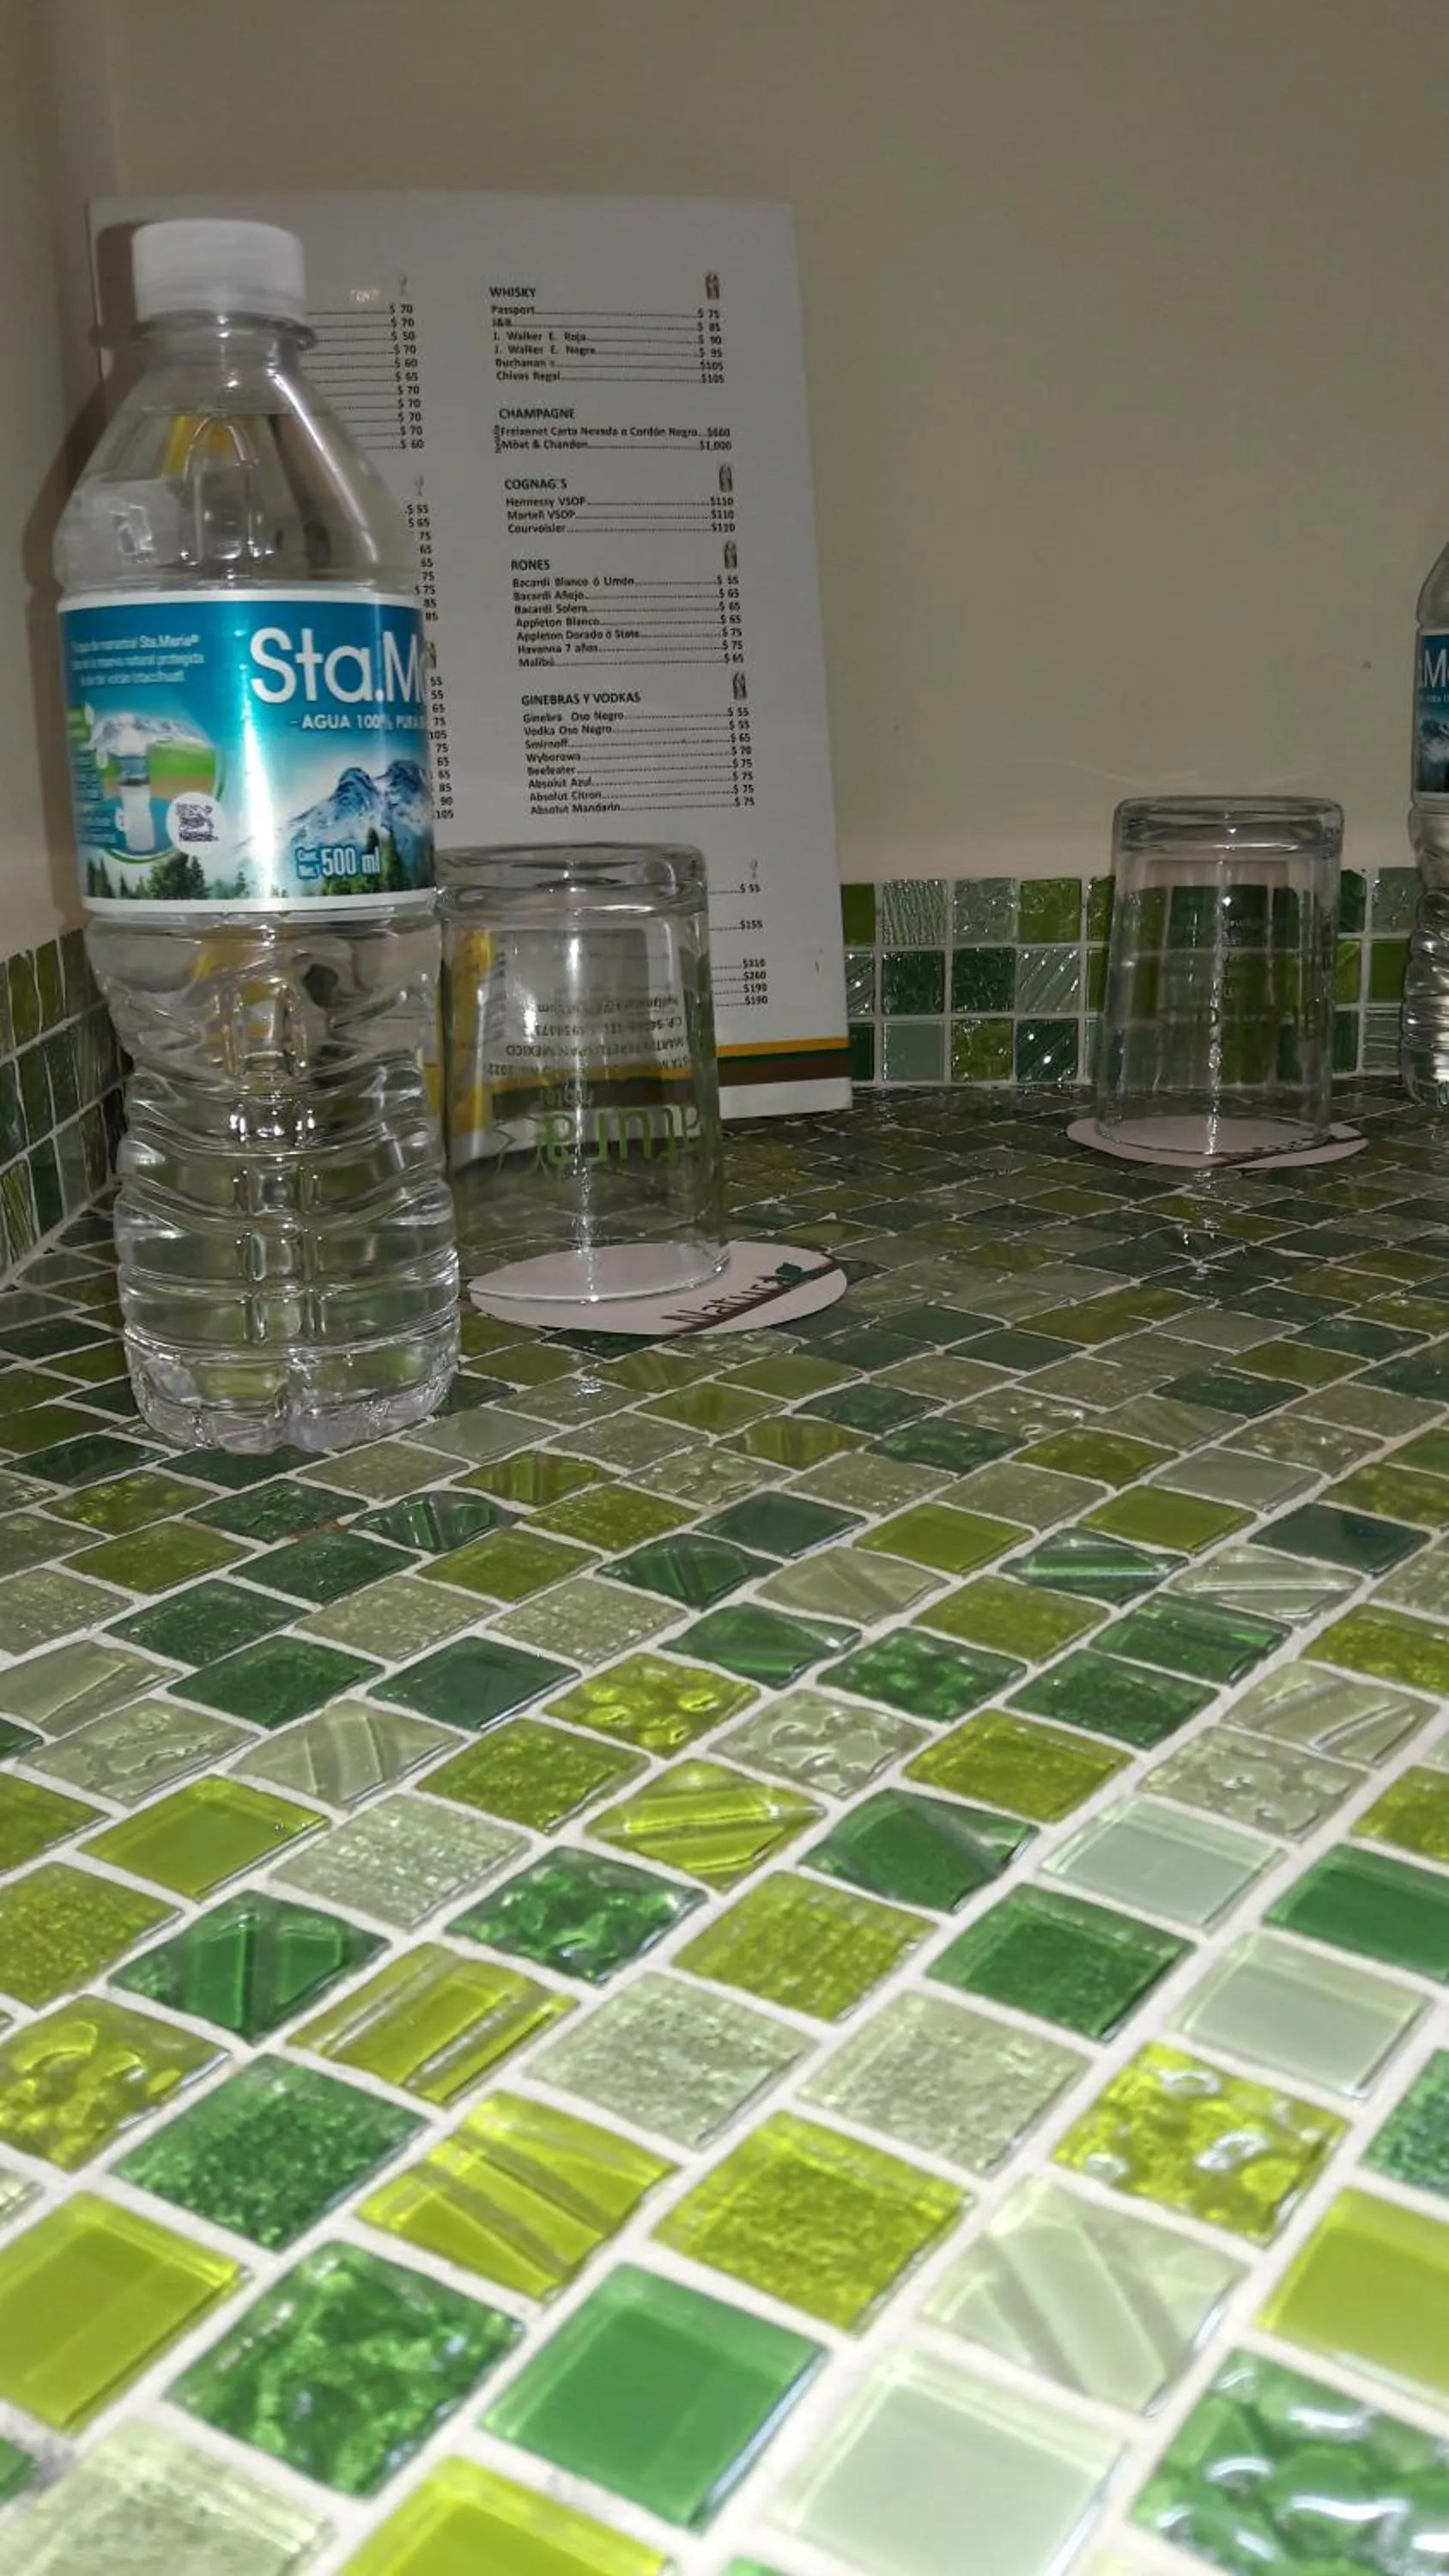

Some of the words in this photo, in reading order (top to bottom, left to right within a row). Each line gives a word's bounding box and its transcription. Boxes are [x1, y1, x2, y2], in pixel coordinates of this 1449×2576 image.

[489, 287, 536, 298] WHISKY
[491, 305, 535, 315] Passport
[506, 331, 542, 341] Walker
[508, 344, 543, 354] Walker
[496, 371, 530, 380] Chivas
[499, 408, 575, 420] CHAMPAGNE
[550, 426, 578, 436] Carta
[532, 439, 540, 448] &
[557, 496, 585, 506] VSOP
[547, 510, 576, 519] VSOP
[511, 559, 550, 571] RONES
[512, 576, 550, 587] Bacardi
[554, 576, 589, 586] Blanco
[516, 617, 562, 629] Appleton
[516, 631, 563, 642] Appleton
[566, 629, 603, 640] Dorado
[564, 643, 570, 653] 7
[250, 626, 424, 704] Sta.M
[522, 694, 580, 705] GINEBRAS
[584, 694, 591, 704] Y
[592, 692, 641, 703] VODKAS
[593, 712, 624, 721] Negro
[301, 714, 352, 730] AGUA
[581, 726, 612, 735] Negro
[529, 792, 568, 801] Absolut
[571, 791, 602, 801] Citron
[320, 846, 357, 877] 500
[361, 845, 380, 874] ml
